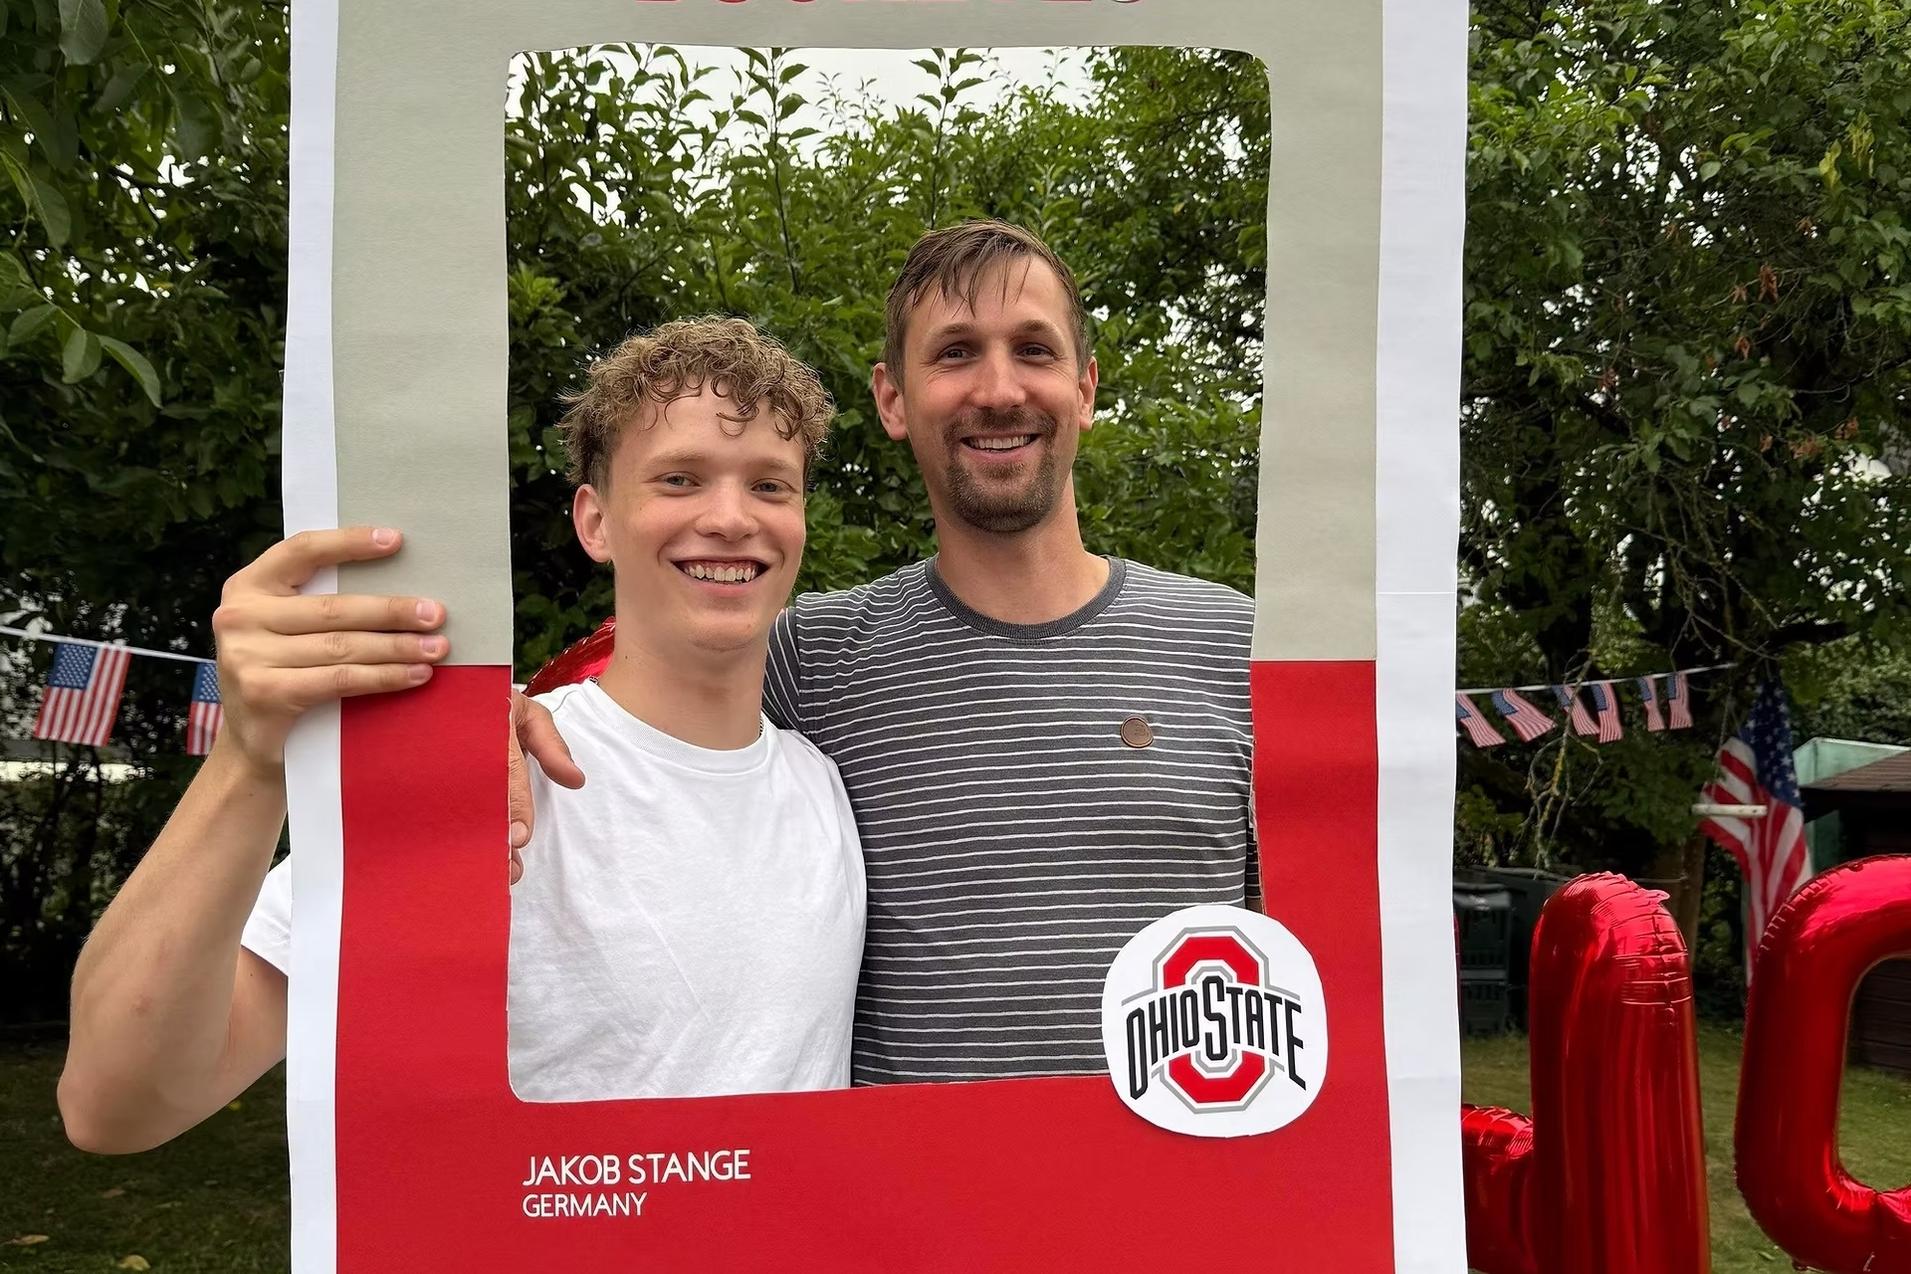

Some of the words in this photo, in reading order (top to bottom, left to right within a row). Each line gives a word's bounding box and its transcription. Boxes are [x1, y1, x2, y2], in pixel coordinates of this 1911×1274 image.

[1126, 988, 1200, 1100] OHIO
[1202, 975, 1307, 1091] STATE
[522, 1154, 622, 1188] JAKOB
[627, 1149, 752, 1185] STANGE
[522, 1192, 648, 1218] GERMANY
